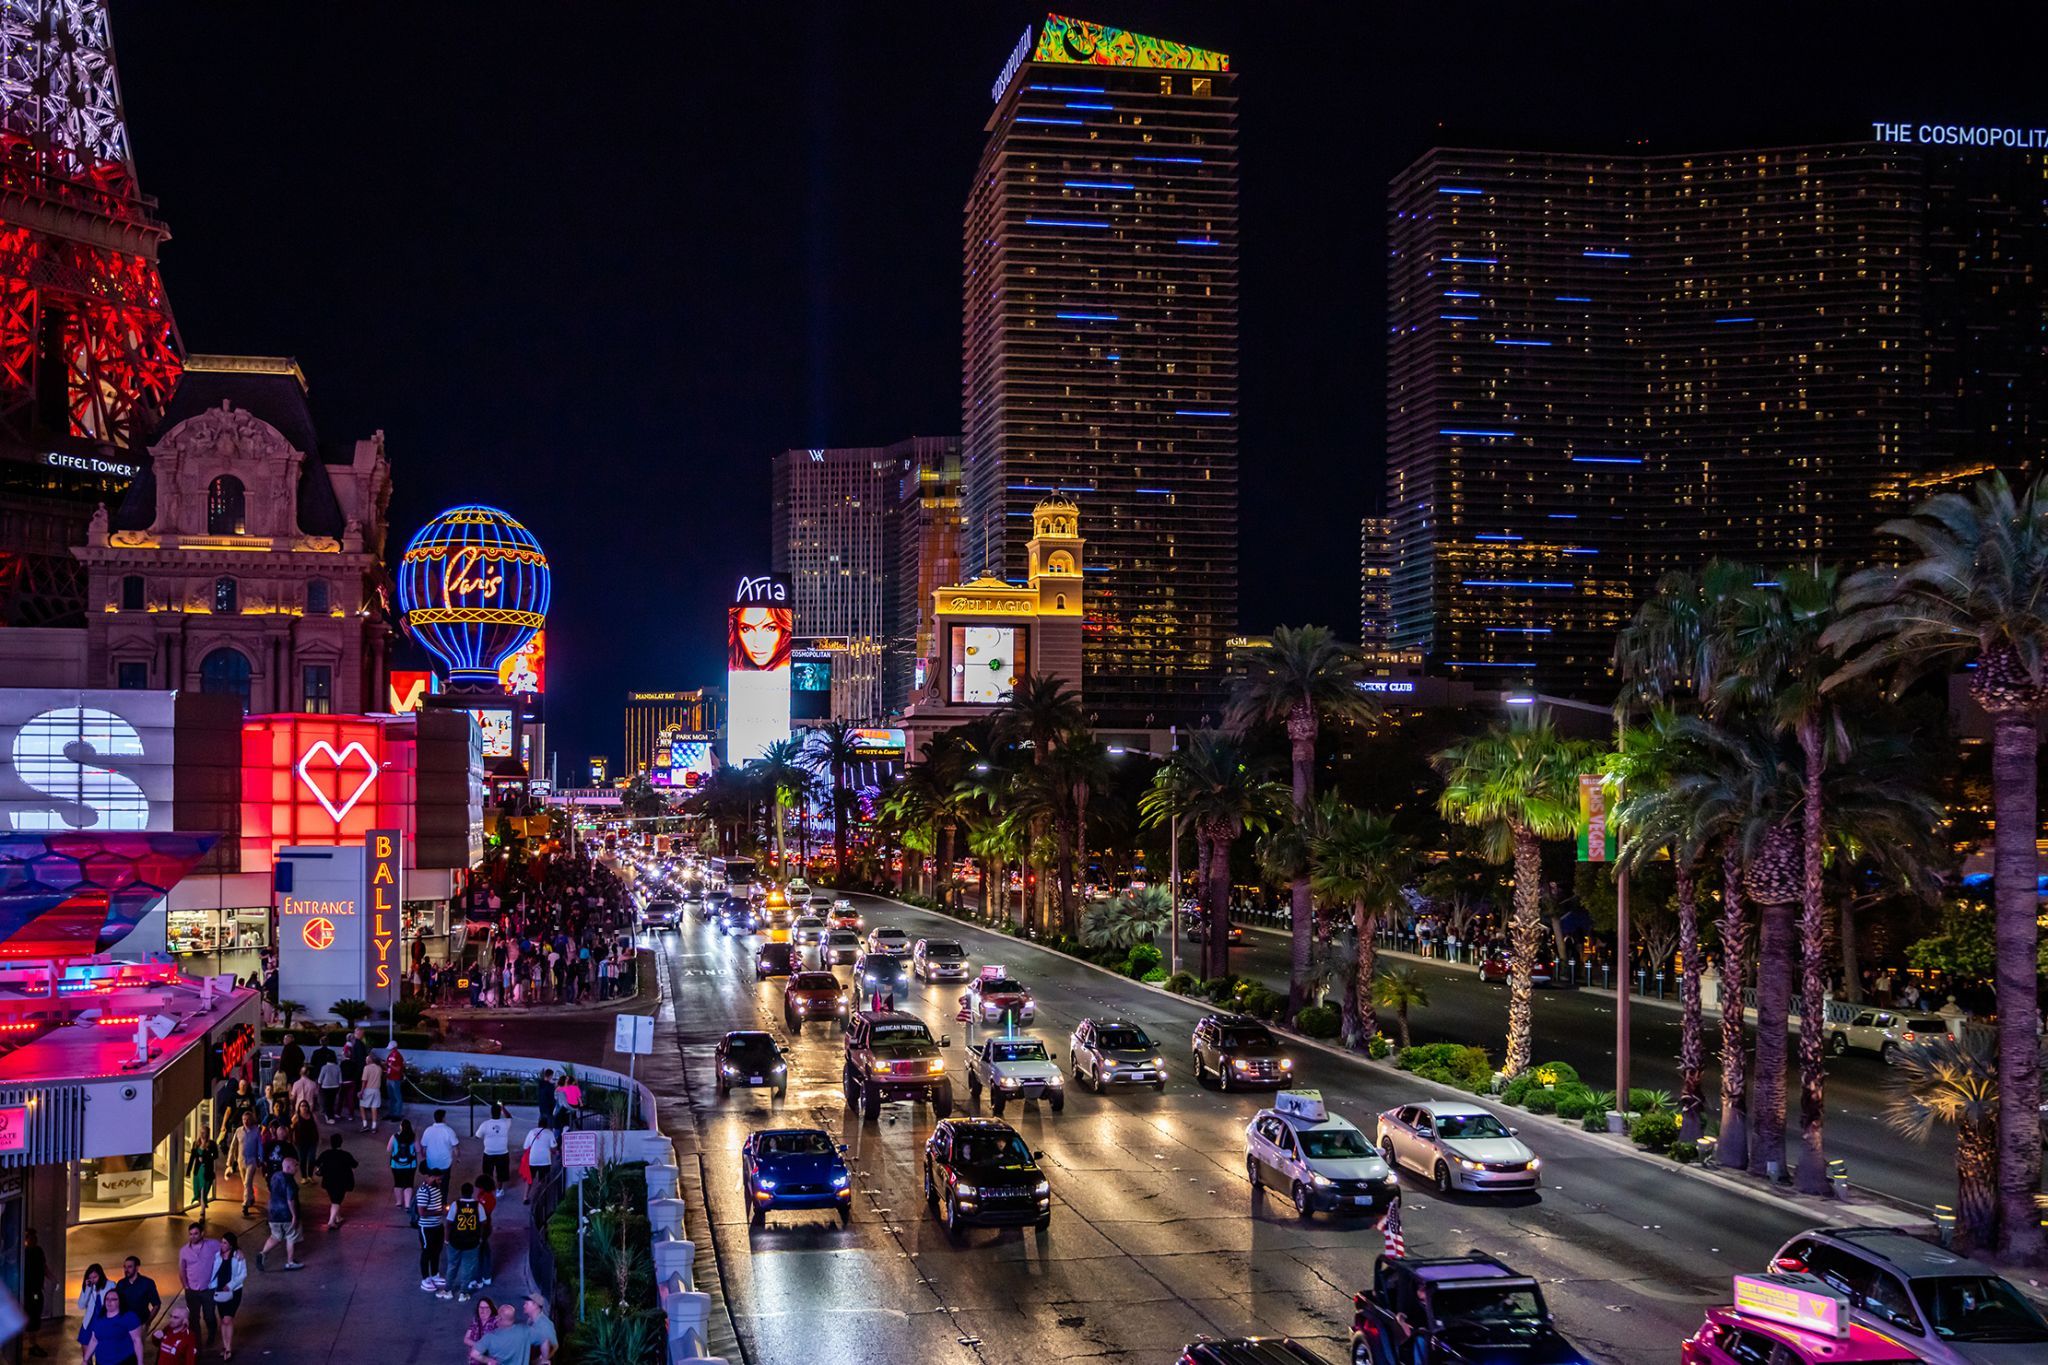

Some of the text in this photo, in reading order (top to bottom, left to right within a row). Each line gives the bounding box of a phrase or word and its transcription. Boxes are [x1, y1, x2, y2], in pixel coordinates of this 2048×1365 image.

[1872, 122, 1912, 142] THE
[49, 453, 131, 476] EIFFEL TOWER
[444, 546, 502, 614] Paris
[736, 576, 786, 602] Aria
[950, 597, 1032, 613] BELLAGIO
[1389, 682, 1413, 691] CLUB
[1588, 815, 1605, 858] VEGAS
[284, 896, 355, 916] ENTRANCE
[373, 835, 391, 989] BALLYS
[875, 1024, 925, 1032] AMERICAN PATRIOTS
[457, 1214, 477, 1230] 24
